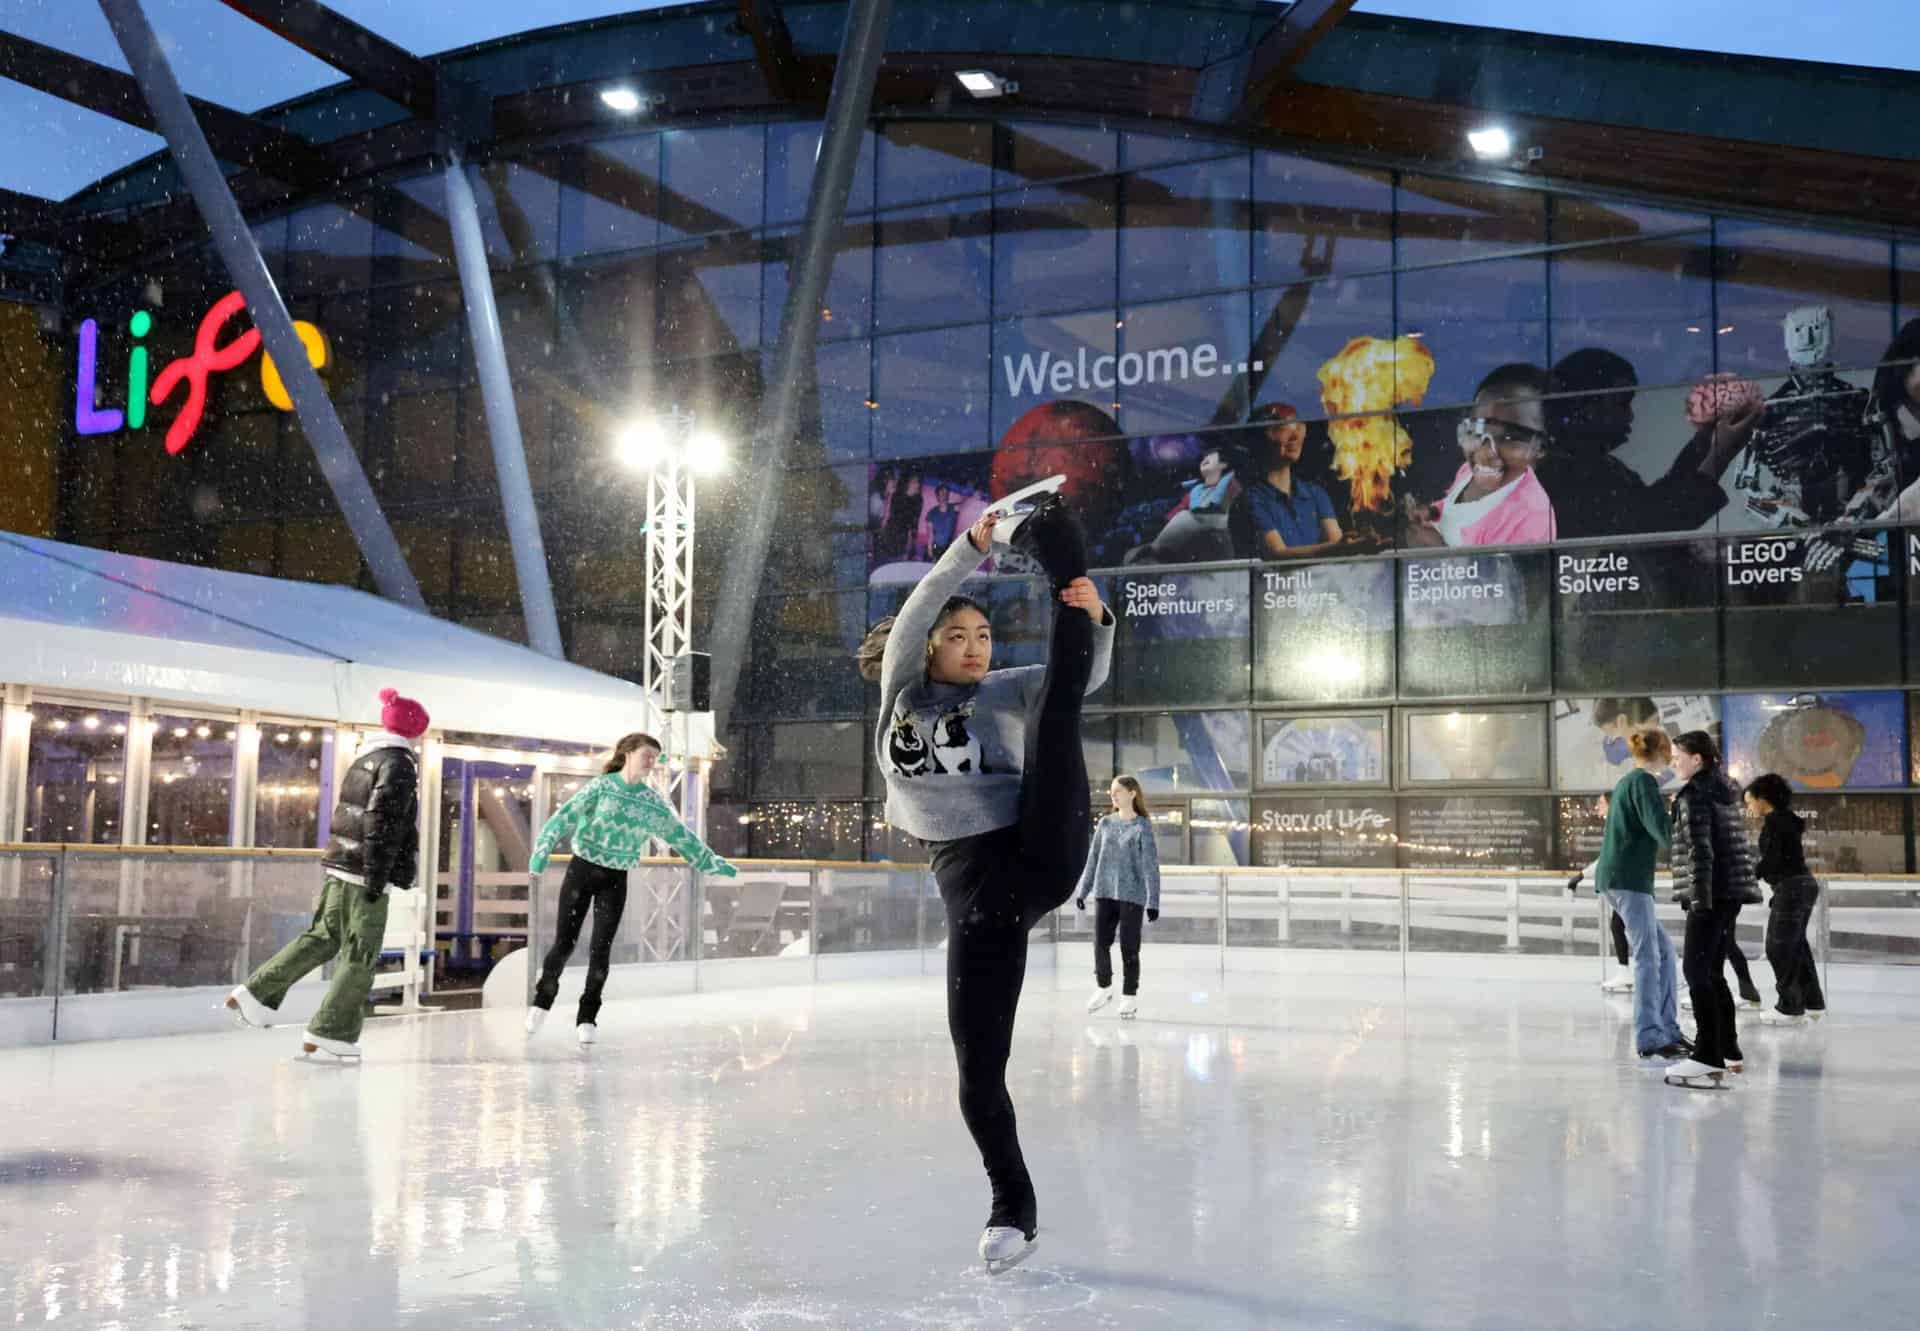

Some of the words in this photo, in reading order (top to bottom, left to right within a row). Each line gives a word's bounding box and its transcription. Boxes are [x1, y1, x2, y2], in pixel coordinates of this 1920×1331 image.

[1003, 342, 1264, 397] Welcome...
[1407, 561, 1479, 583] Excited
[1558, 552, 1629, 574] Puzzle
[1263, 571, 1313, 591] Thrill
[1558, 575, 1641, 595] Solvers
[1727, 565, 1804, 585] Lovers
[1125, 581, 1177, 601] Space
[1263, 591, 1339, 609] Seekers
[1407, 583, 1505, 605] Explorers
[1125, 597, 1234, 617] Adventurers
[1262, 809, 1311, 829] Story
[1314, 809, 1333, 829] of
